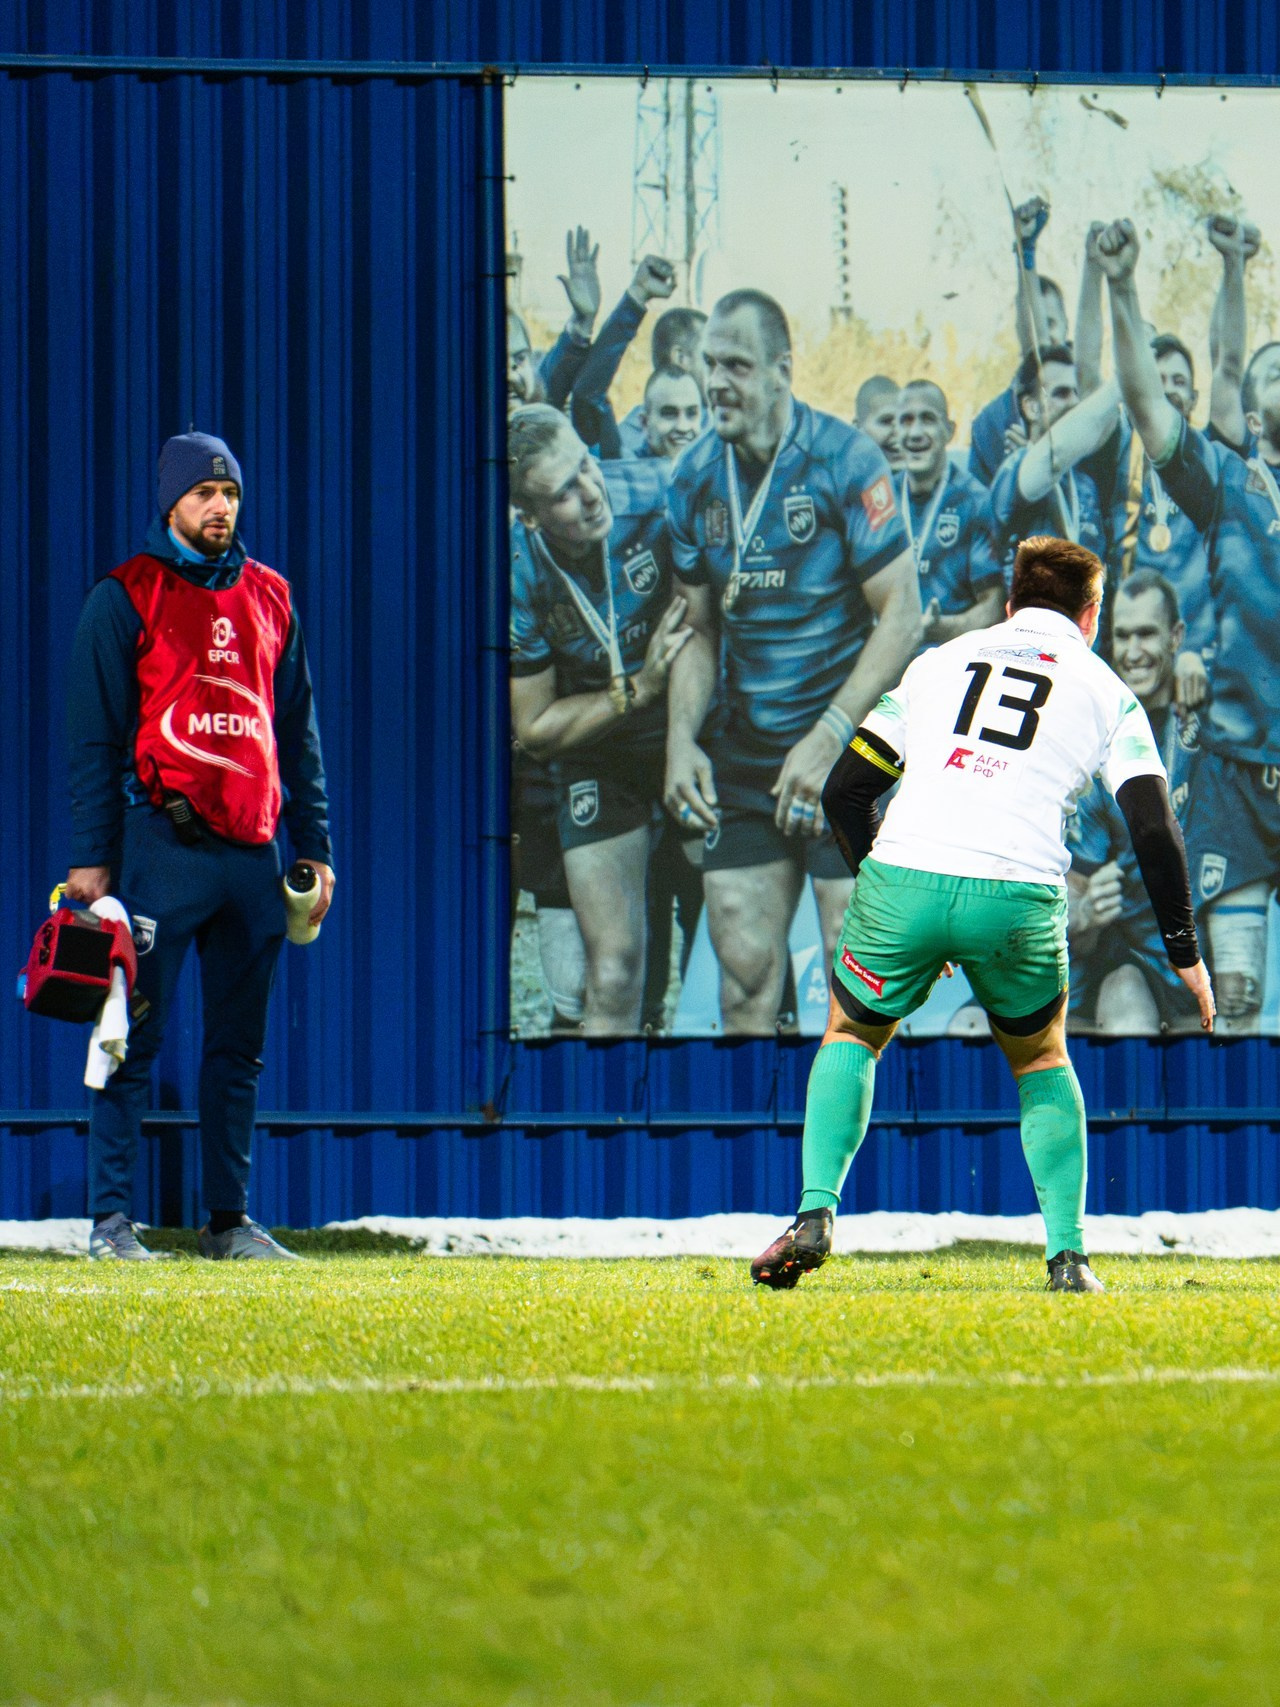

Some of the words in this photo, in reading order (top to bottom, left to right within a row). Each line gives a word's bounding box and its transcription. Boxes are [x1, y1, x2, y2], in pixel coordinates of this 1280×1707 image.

[208, 649, 240, 664] EPCR
[953, 661, 1053, 751] 13
[188, 712, 262, 740] MEDIC
[973, 764, 994, 778] РФ
[976, 754, 1009, 771] АГАТ
